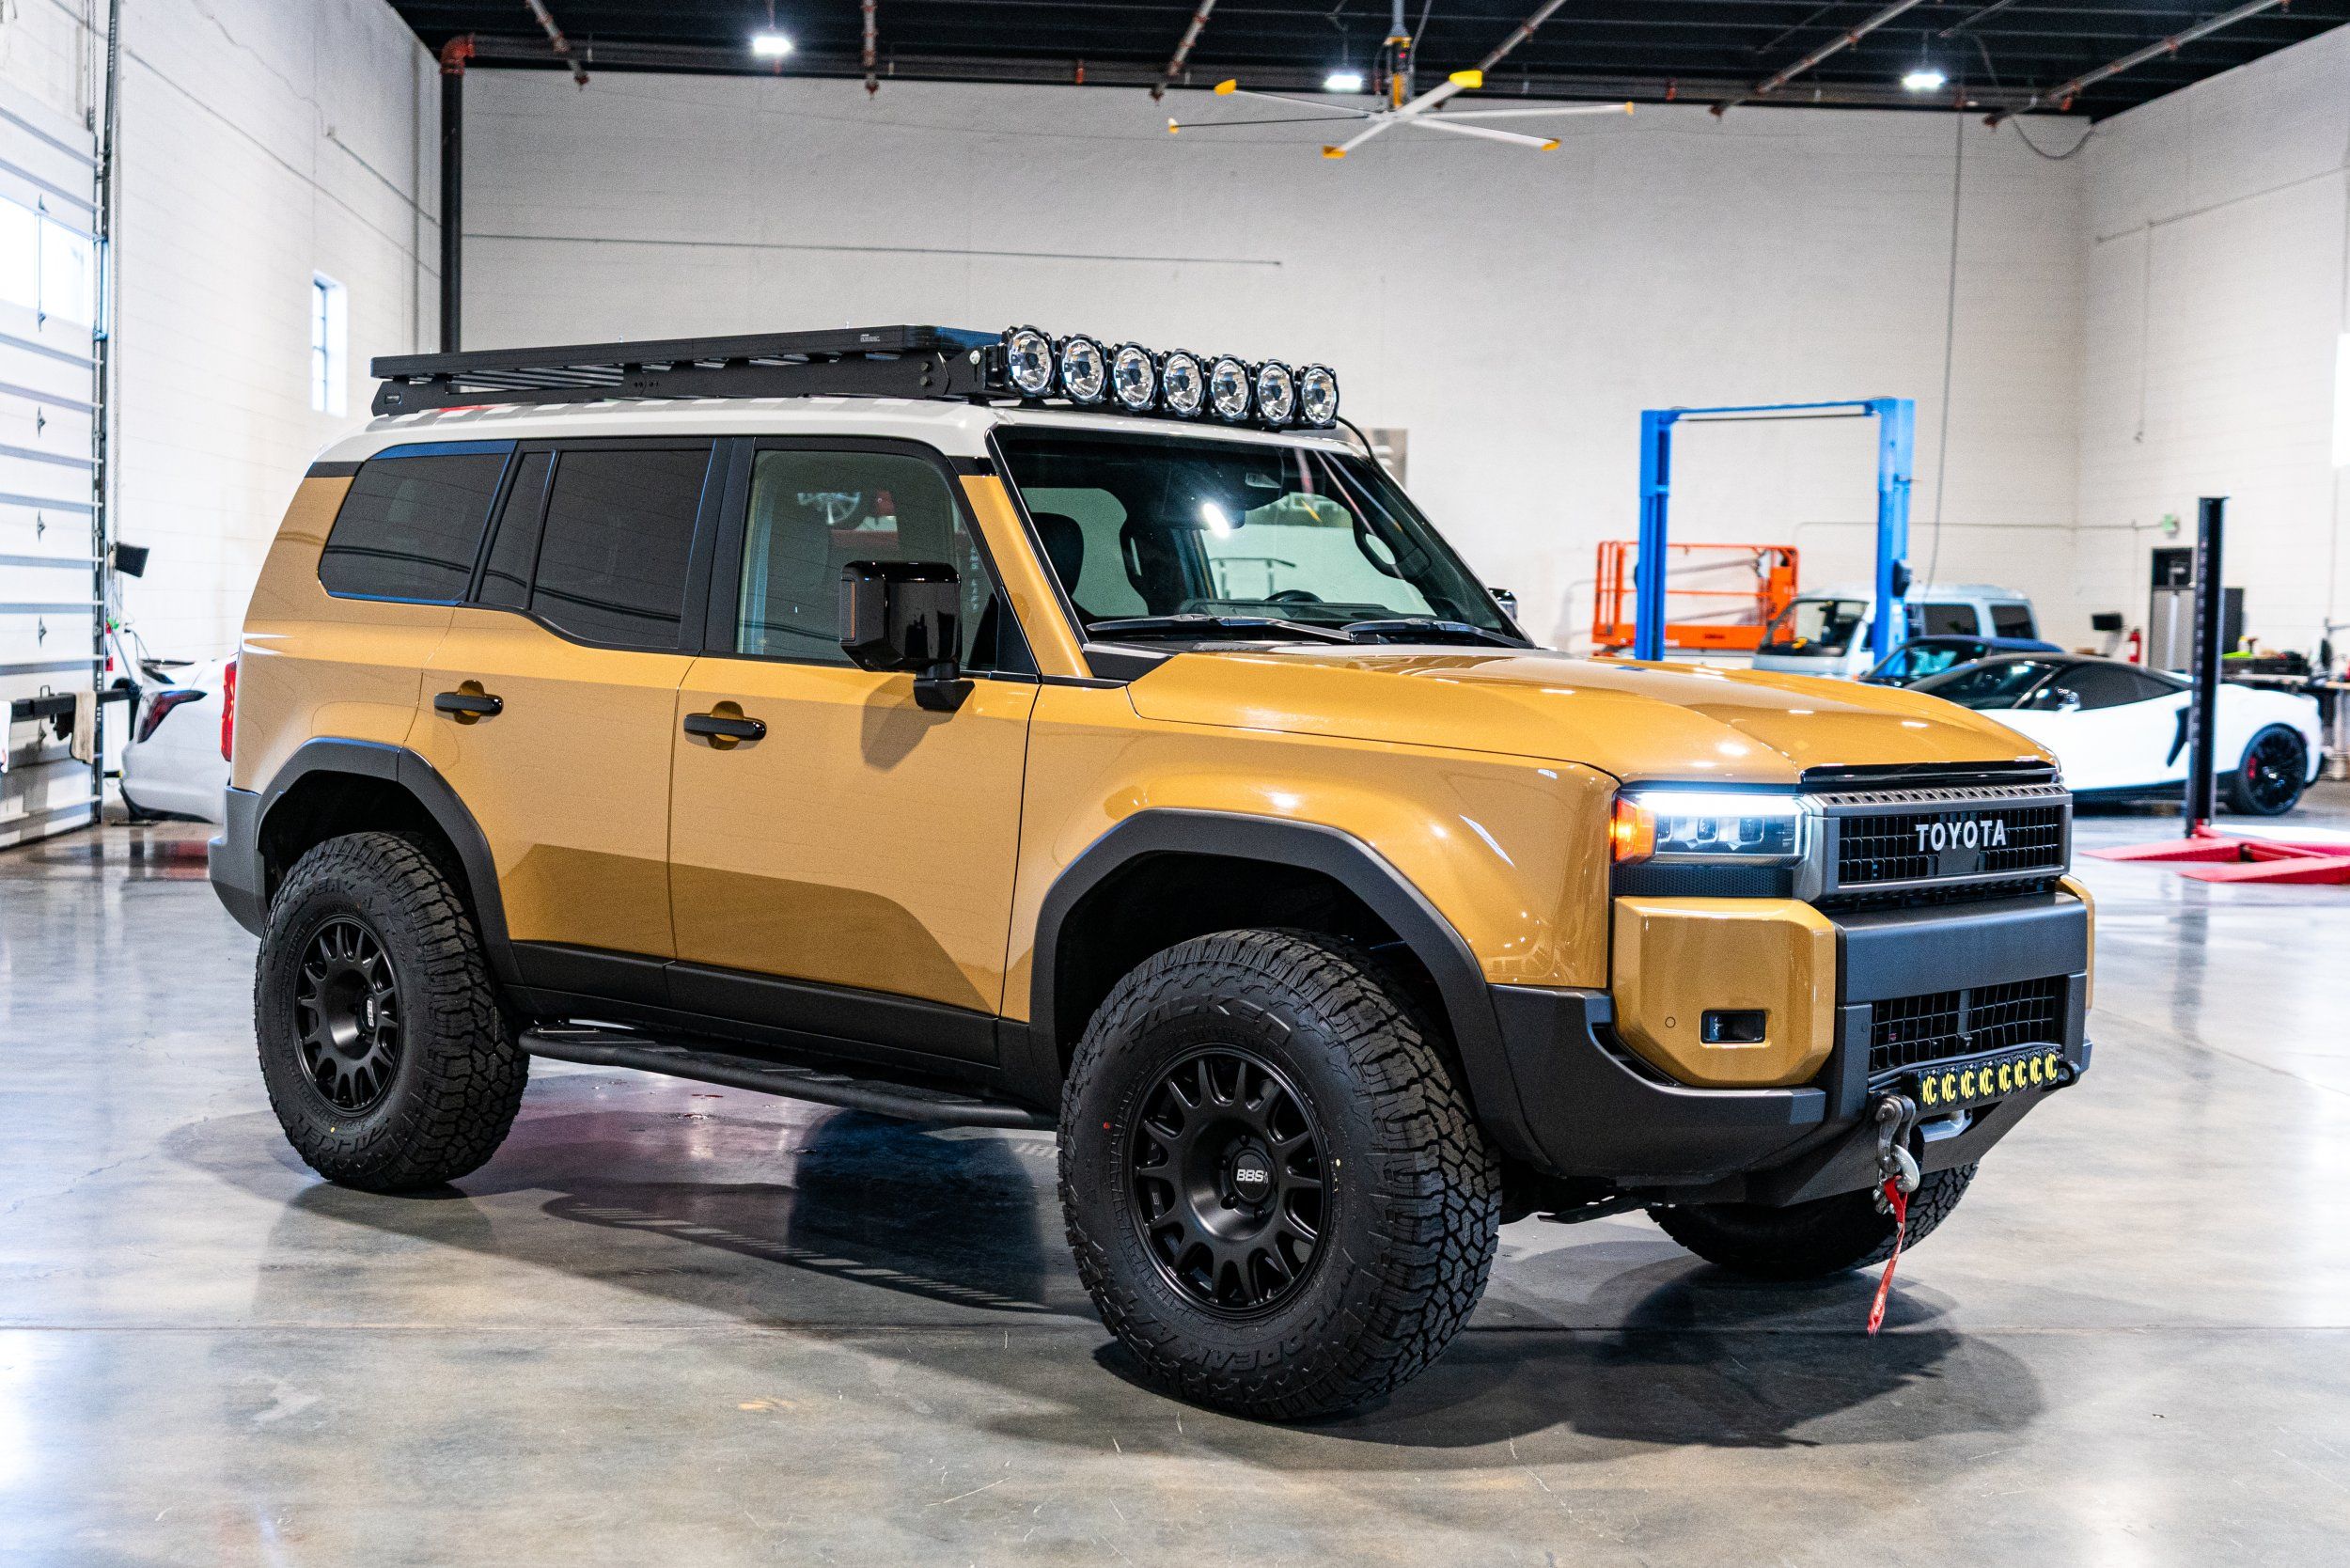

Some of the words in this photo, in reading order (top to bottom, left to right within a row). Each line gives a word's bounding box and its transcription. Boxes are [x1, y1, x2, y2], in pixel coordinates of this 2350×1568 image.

[1915, 819, 2007, 852] TOYOTA
[1922, 1075, 1937, 1105] KC
[1941, 1073, 1956, 1102] KC
[1960, 1070, 1975, 1099] KC
[1979, 1067, 1994, 1096] KC
[1998, 1063, 2012, 1091] KC
[2014, 1059, 2027, 1088] KC
[2029, 1056, 2042, 1084] KC
[2044, 1053, 2057, 1080] KC
[1236, 1168, 1264, 1183] BBS
